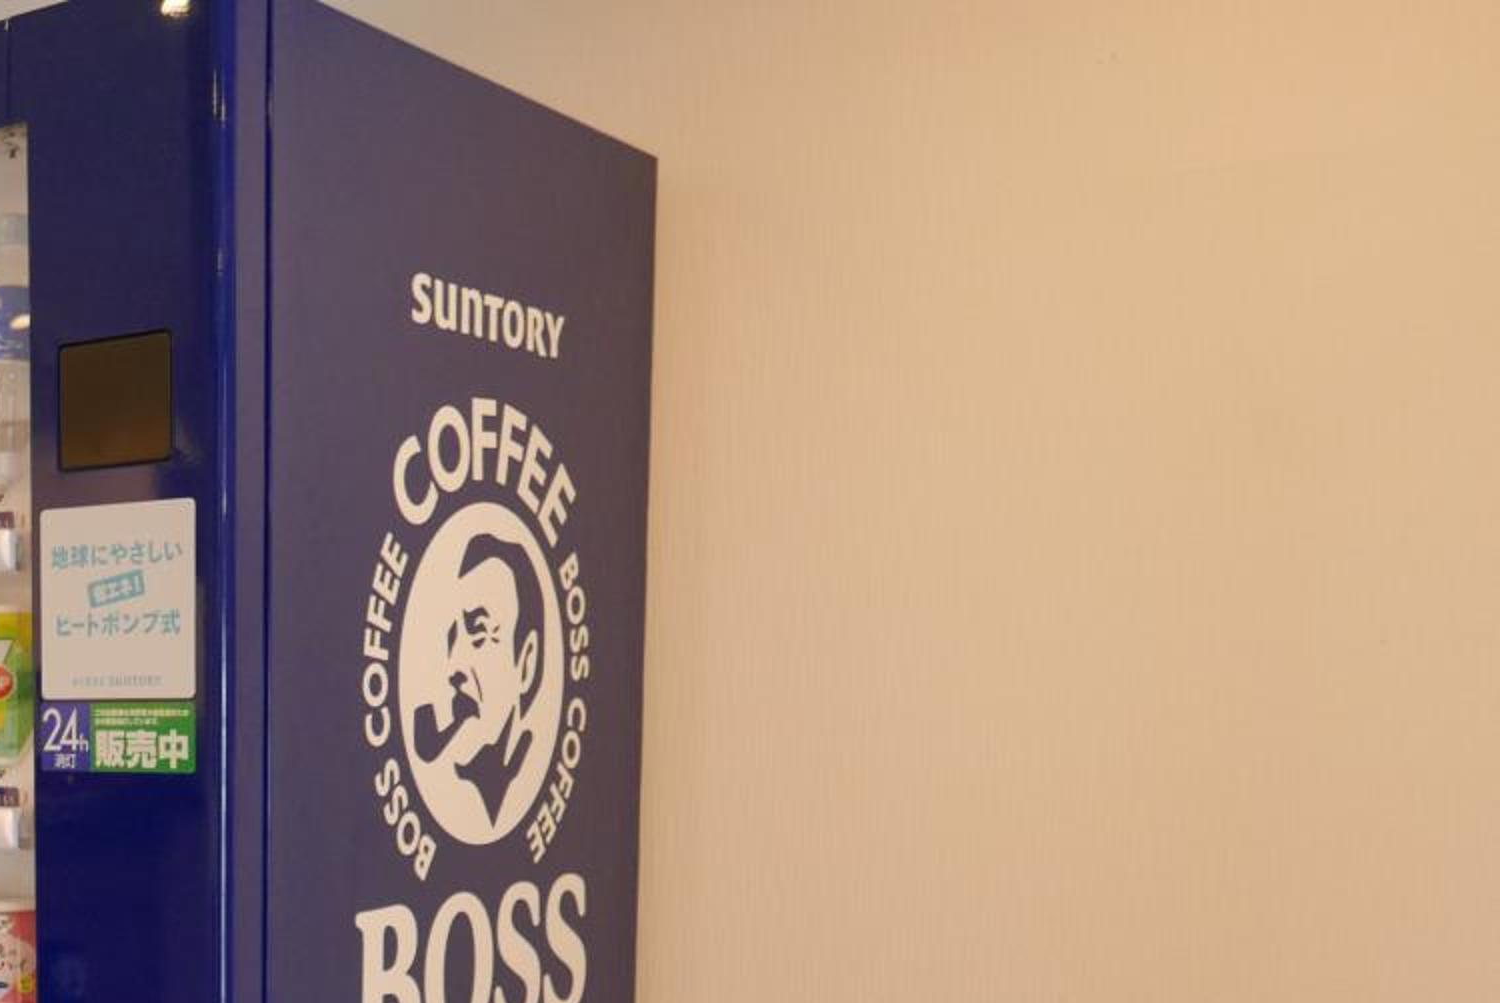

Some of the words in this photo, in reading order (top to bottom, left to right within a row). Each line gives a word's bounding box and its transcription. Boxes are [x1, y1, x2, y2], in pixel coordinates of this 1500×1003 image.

[411, 271, 565, 358] SUNTORY
[393, 397, 576, 548] COFFEE
[51, 540, 182, 569] 地球にやさしい
[55, 608, 181, 637] ヒートポンプ式
[362, 532, 410, 748] COFFEE
[559, 552, 590, 682] BOSS
[95, 729, 189, 770] 販売中
[527, 697, 587, 864] COFFEE
[375, 758, 437, 881] BOSS
